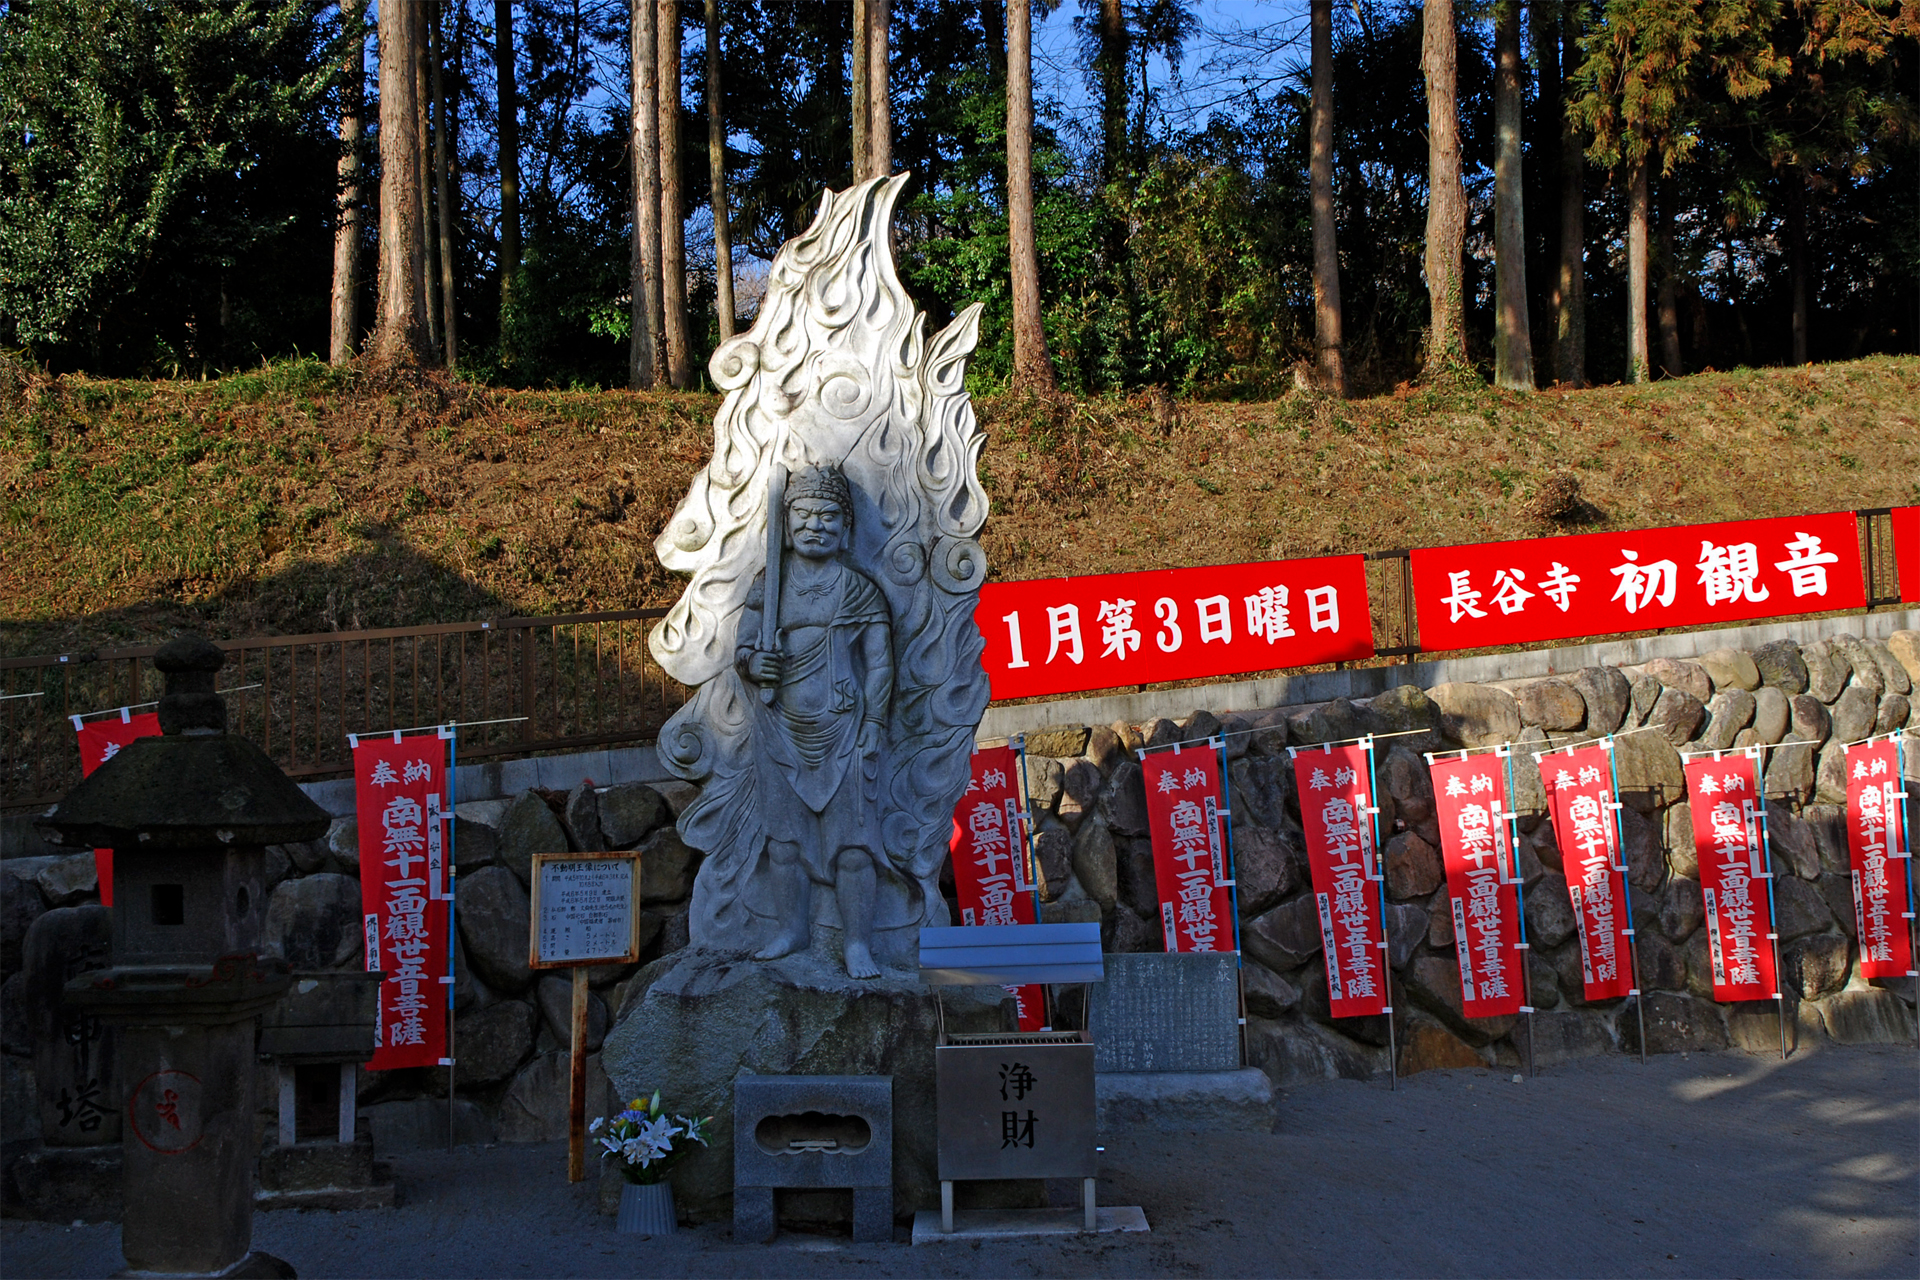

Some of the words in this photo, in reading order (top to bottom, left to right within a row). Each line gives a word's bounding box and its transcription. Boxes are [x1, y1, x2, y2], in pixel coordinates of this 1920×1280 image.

[1440, 561, 1581, 624] 長谷寺
[1610, 530, 1839, 614] 初観音
[1003, 585, 1341, 670] 1月第3日曜日
[370, 758, 431, 788] 奉納
[1157, 767, 1207, 795] 奉納
[1309, 765, 1358, 791] 奉納
[1445, 773, 1494, 798] 奉納
[1554, 765, 1601, 791] 奉納
[1698, 772, 1745, 796] 奉納
[1852, 757, 1888, 781] 奉納
[1322, 796, 1378, 999] 南無十一面観世音菩薩
[1458, 803, 1511, 999] 南無十一面観世音菩薩
[1569, 794, 1618, 982] 南無十一面観世音菩薩
[1710, 800, 1761, 985] 南無十一面観世音菩薩
[1859, 784, 1893, 962] 南無十一面観世音菩薩
[382, 796, 429, 1048] 南無十一面観世音菩薩
[998, 1062, 1039, 1150] 浄財
